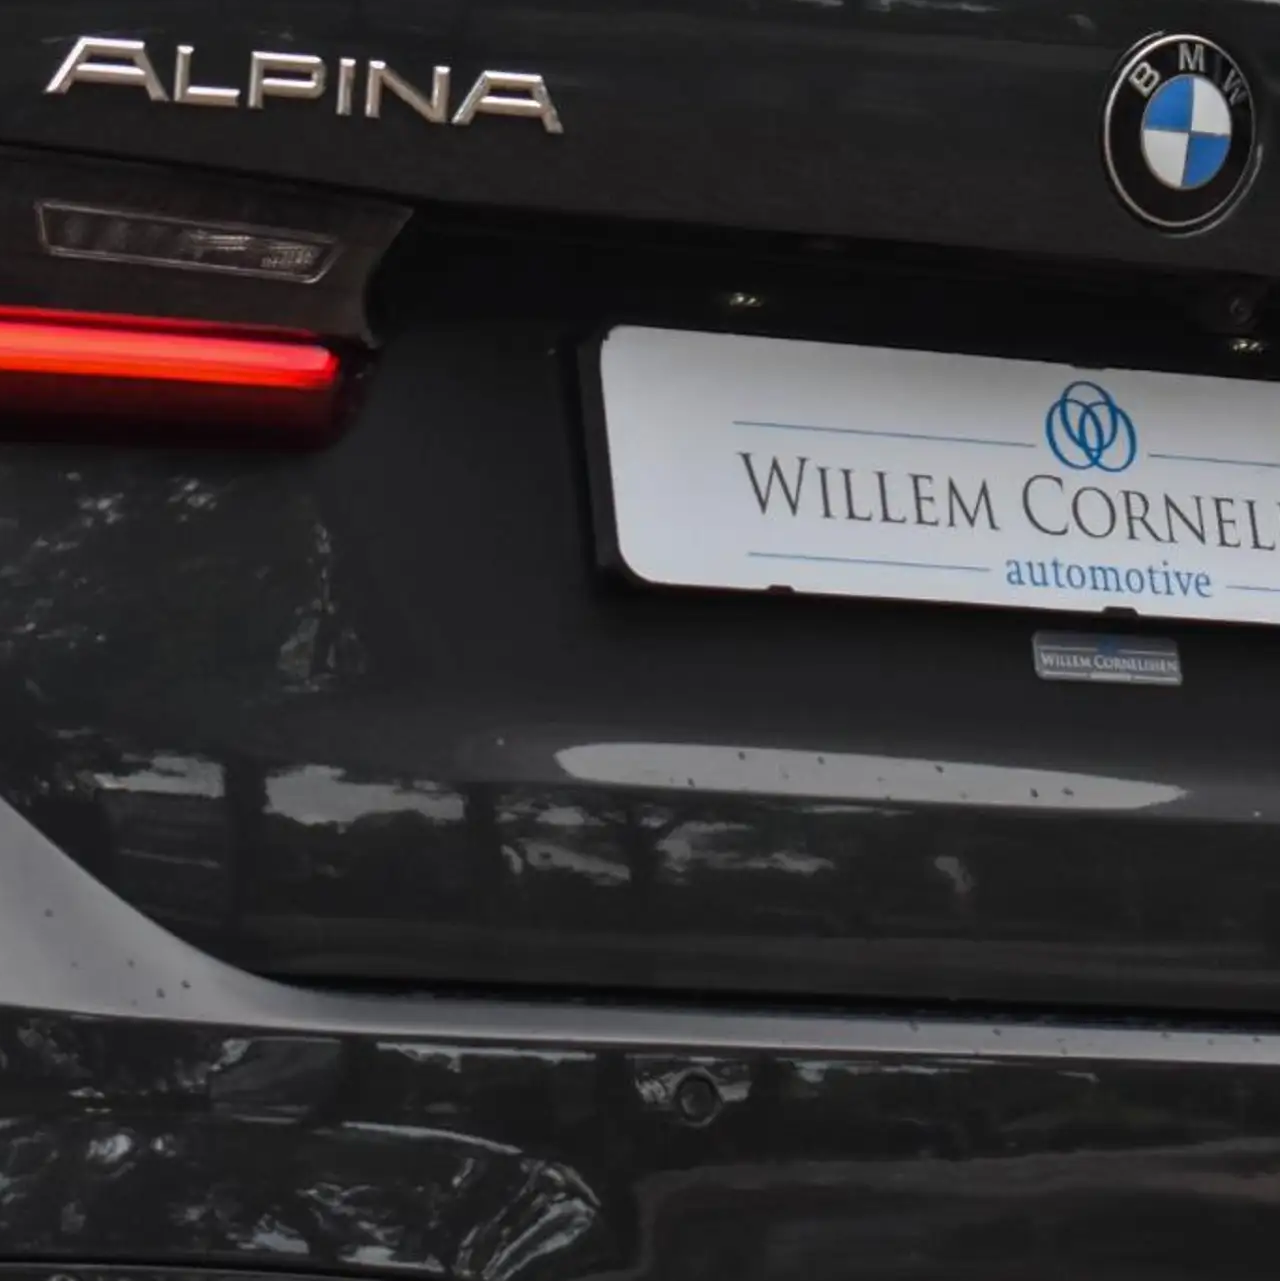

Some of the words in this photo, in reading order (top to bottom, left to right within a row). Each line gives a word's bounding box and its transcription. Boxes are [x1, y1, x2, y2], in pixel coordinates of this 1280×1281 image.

[44, 35, 563, 133] ALPINA
[1128, 42, 1246, 106] BMW
[735, 451, 1001, 532] WILLEM
[1006, 558, 1213, 598] automotive
